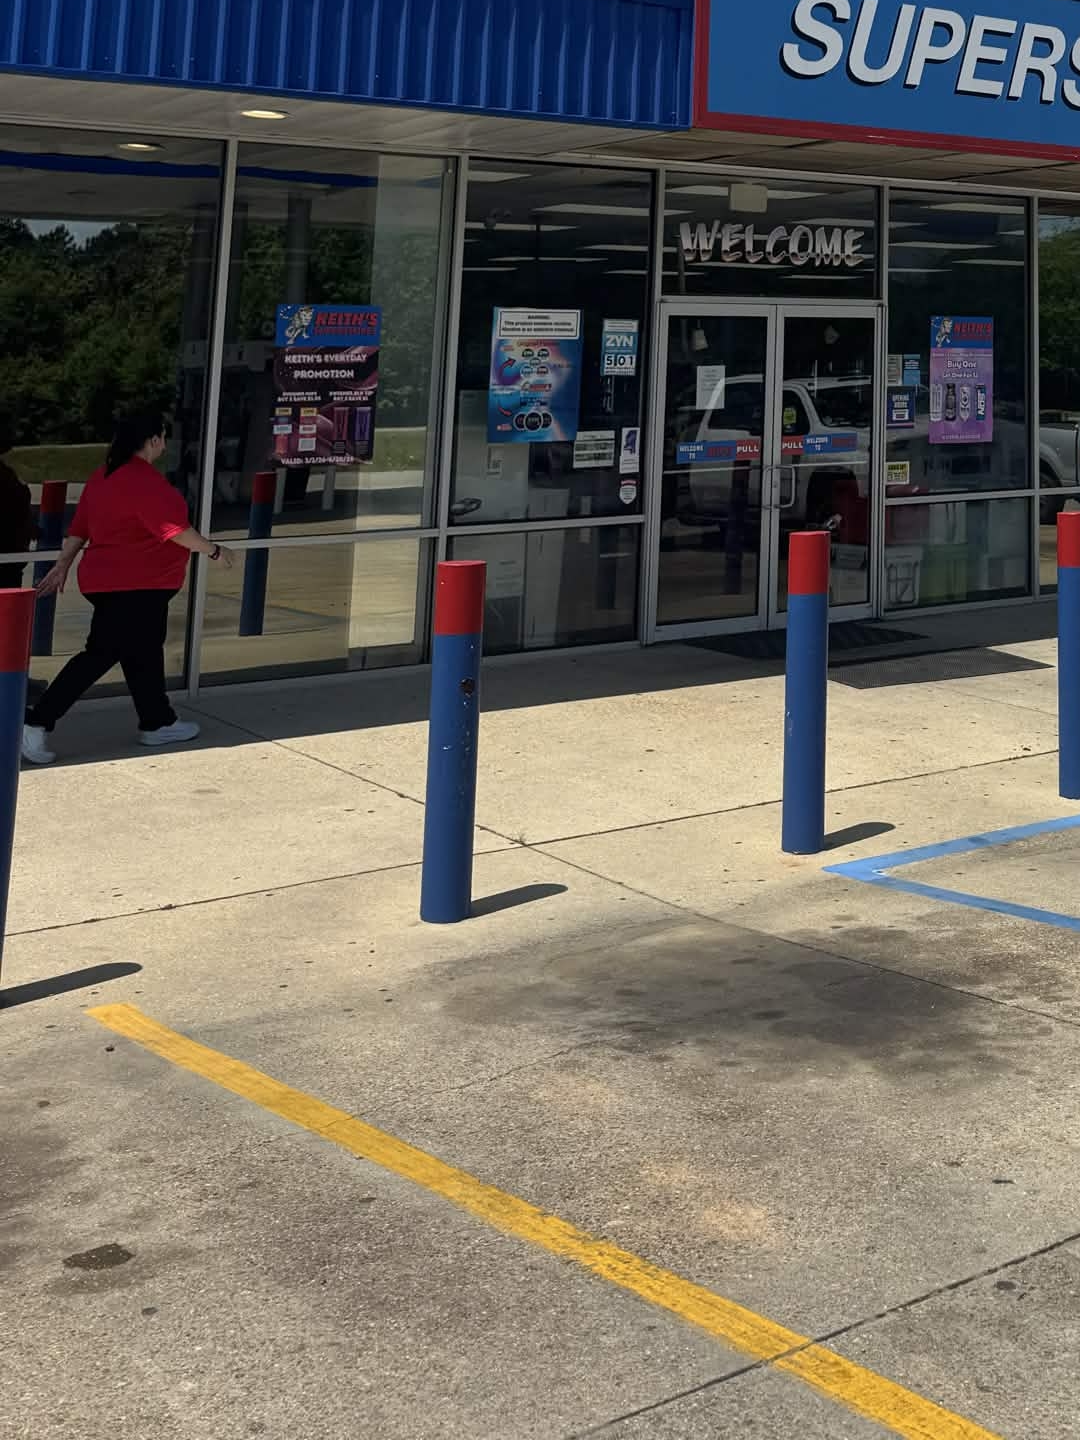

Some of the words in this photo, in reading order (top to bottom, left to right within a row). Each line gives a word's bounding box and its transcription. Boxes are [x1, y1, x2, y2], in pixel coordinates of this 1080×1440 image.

[679, 220, 865, 268] WELCOME
[314, 312, 379, 327] KEITH'S
[605, 335, 634, 347] ZYN
[284, 353, 322, 364] KEITH'S
[324, 353, 368, 363] EVERYDAY
[293, 369, 355, 379] PROMOTION
[736, 445, 759, 453] PULL
